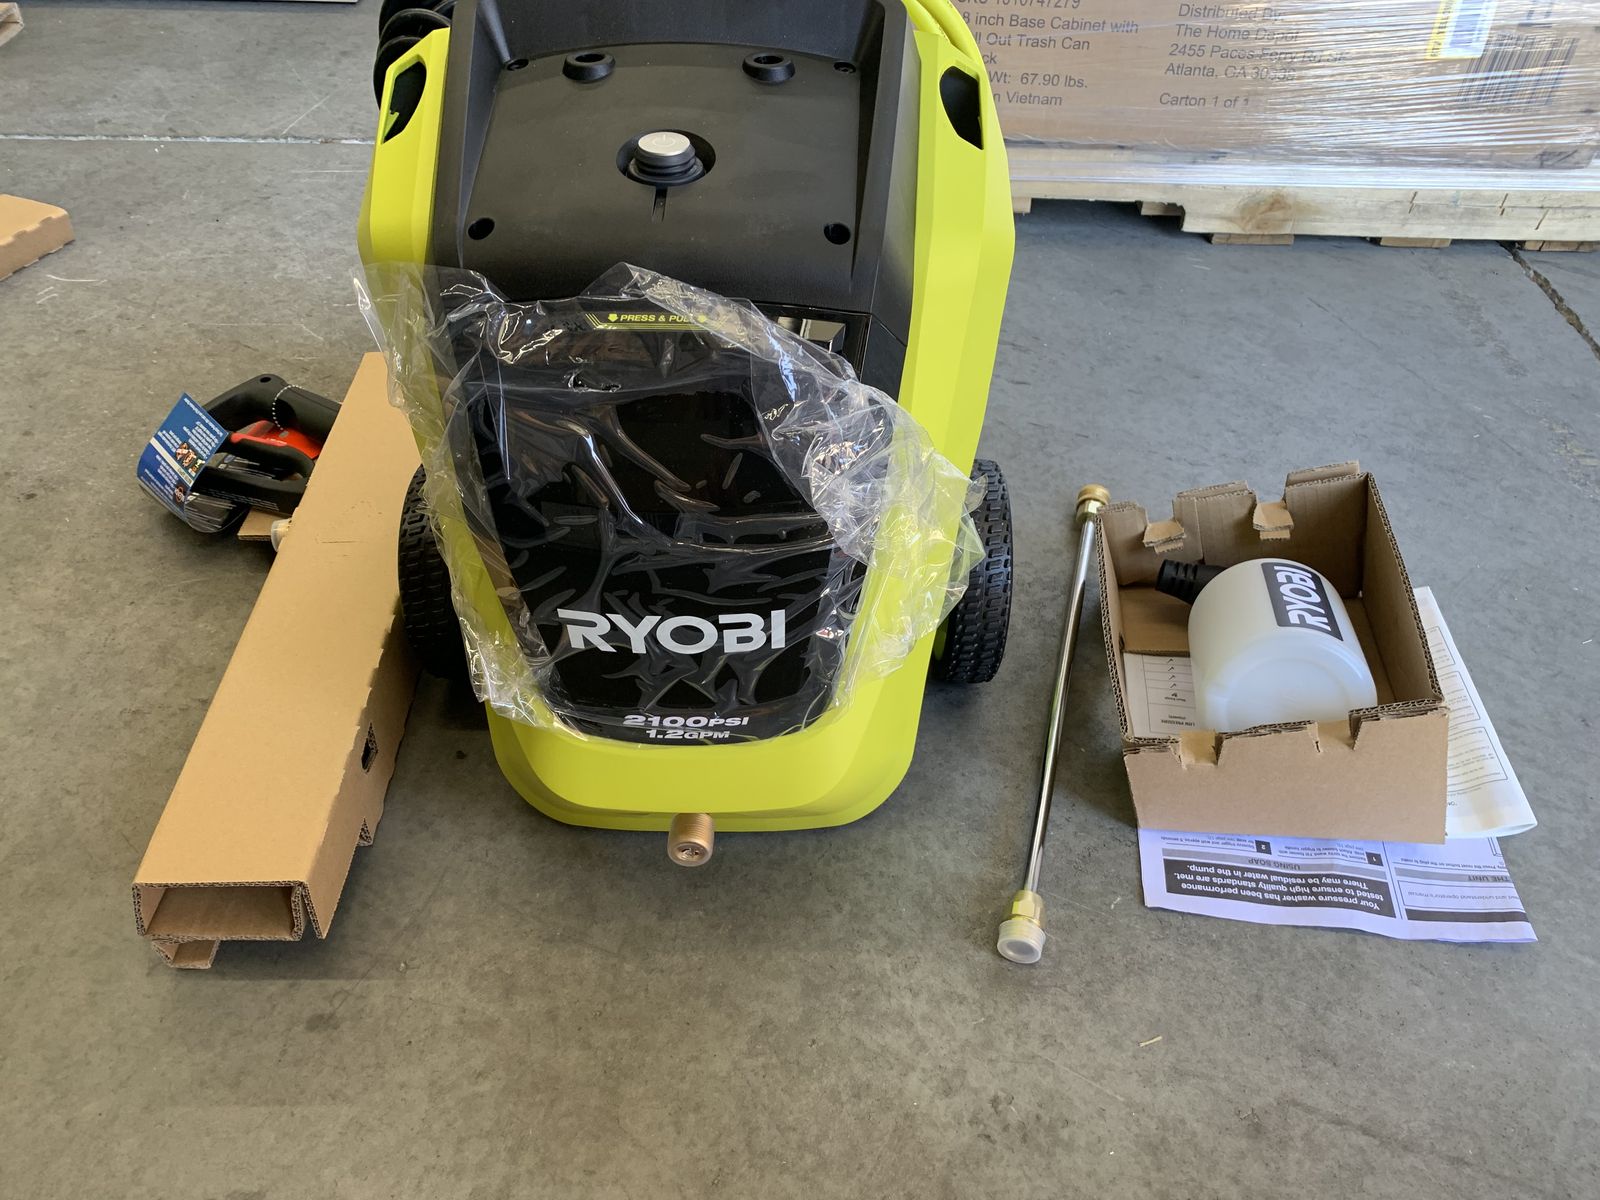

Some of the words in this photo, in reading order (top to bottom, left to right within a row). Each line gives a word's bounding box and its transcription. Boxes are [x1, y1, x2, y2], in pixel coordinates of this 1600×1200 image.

[1178, 3, 1258, 19] Distributed
[975, 13, 1004, 27] inch
[1009, 14, 1046, 28] Base
[1050, 16, 1106, 32] Cabinet
[1110, 21, 1139, 34] with
[1175, 24, 1203, 38] The
[1206, 25, 1250, 40] Home
[986, 32, 1012, 47] Out
[1017, 34, 1056, 49] Trash
[1061, 37, 1090, 50] Can
[1169, 43, 1206, 58] 2455
[1164, 63, 1219, 78] Atlanta,
[1020, 72, 1060, 87] 67.90
[1064, 74, 1088, 88] lbs.
[1006, 91, 1062, 106] Vietnam
[1159, 92, 1206, 107] Carton
[1212, 96, 1219, 107] 1
[1223, 96, 1239, 108] of
[620, 314, 656, 322] PRESS
[669, 314, 693, 323] PUL
[1274, 566, 1331, 631] RYOBI
[557, 608, 785, 654] RYOBI
[622, 714, 750, 727] 2100PSI
[646, 729, 730, 740] 1.2GPM
[1187, 864, 1215, 874] pump.
[1216, 868, 1231, 877] the
[1232, 870, 1242, 878] in
[1173, 872, 1194, 881] met.
[1243, 871, 1269, 881] water
[1270, 875, 1306, 885] residual
[1307, 877, 1320, 885] be
[1321, 877, 1341, 885] may
[1181, 882, 1239, 895] performance
[1211, 877, 1256, 889] standards
[1257, 881, 1288, 892] quality
[1342, 879, 1369, 890] There
[1240, 889, 1263, 900] been
[1289, 885, 1310, 894] high
[1311, 886, 1343, 894] ensure
[1344, 888, 1355, 896] to
[1264, 892, 1281, 901] has
[1281, 895, 1316, 903] washer
[1317, 895, 1358, 906] pressure
[1356, 890, 1384, 902] tested
[1360, 900, 1380, 910] Your
